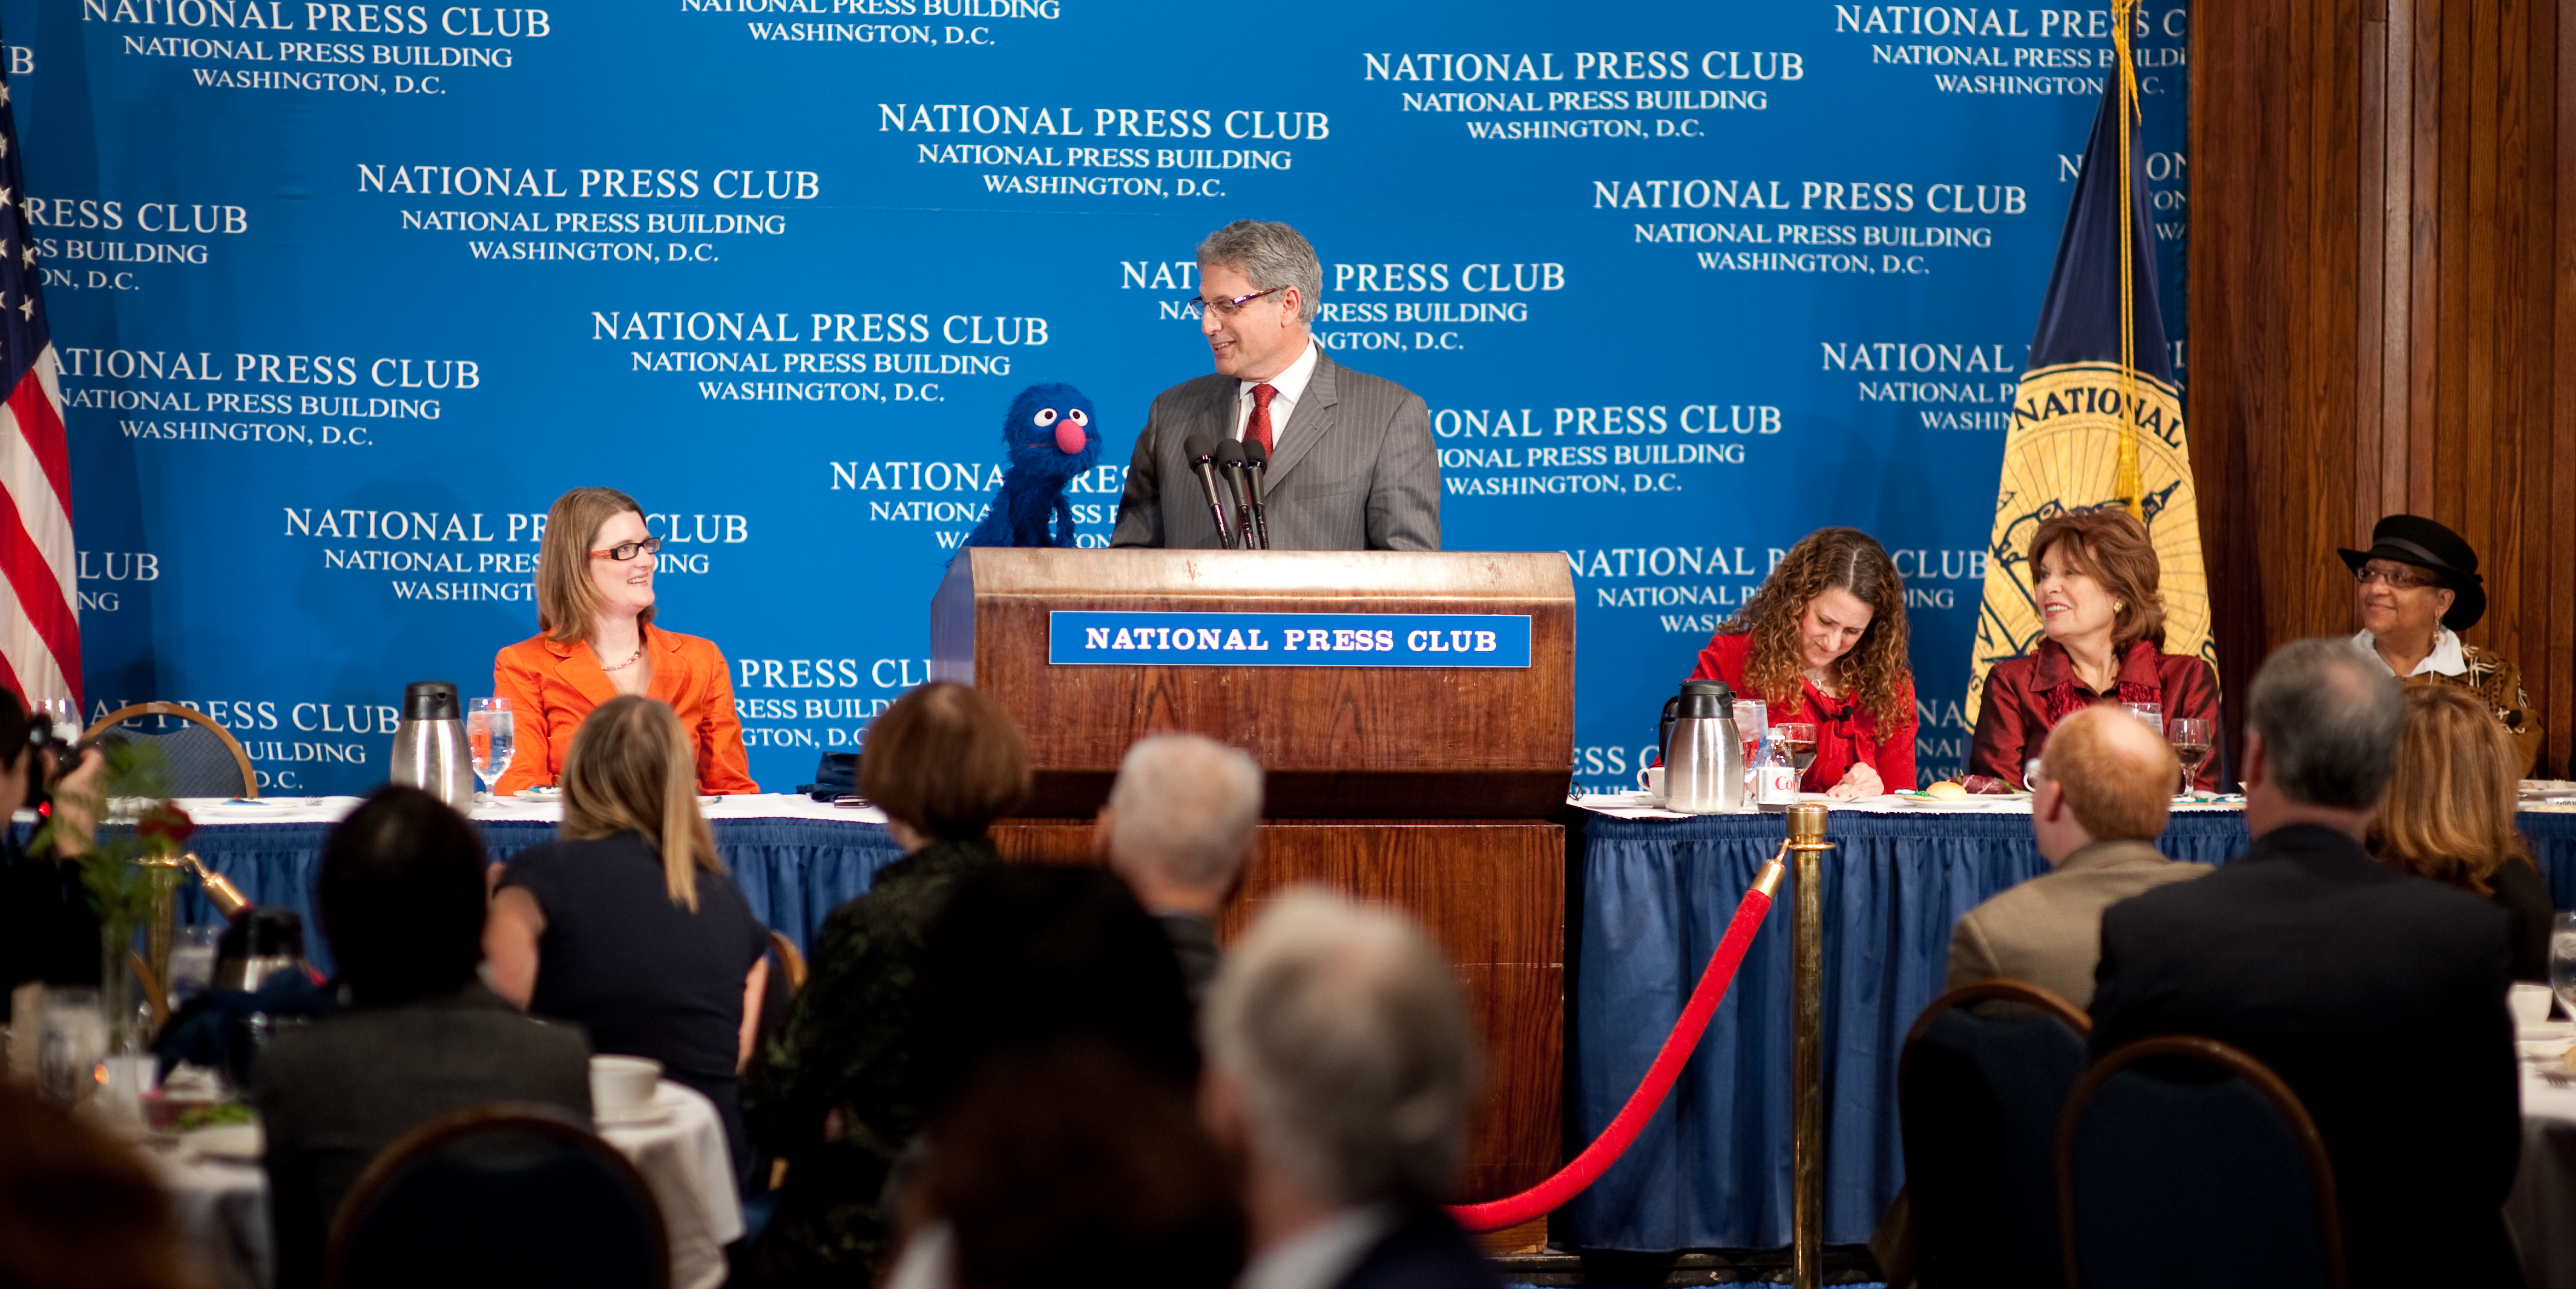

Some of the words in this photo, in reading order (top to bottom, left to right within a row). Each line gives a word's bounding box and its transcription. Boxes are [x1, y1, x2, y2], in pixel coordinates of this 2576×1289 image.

[82, 0, 294, 30] NATIONAL
[306, 3, 427, 34] PRESS
[442, 7, 550, 37] CLUB
[833, 0, 916, 15] PRESS
[924, 0, 1059, 19] BUILDING
[1835, 5, 2028, 36] NATIONAL
[2040, 8, 2150, 38] PRES
[748, 22, 938, 48] WASHINGTON,
[945, 27, 994, 45] D.C.
[123, 36, 272, 60] NATIONAL
[280, 42, 364, 63] PRESS
[373, 45, 512, 67] BUILDING
[1873, 45, 2008, 66] NATIONAL
[2015, 48, 2091, 67] PRESS
[1363, 53, 1563, 81] NATIONAL
[1576, 51, 1689, 79] PRESS
[1703, 51, 1803, 80] CLUB
[193, 69, 386, 94] WASHINGTON,
[395, 76, 445, 94] D.C.
[1402, 93, 1542, 111] NATIONAL
[1549, 91, 1629, 111] PRESS
[1636, 91, 1766, 109] BUILDING
[878, 104, 1082, 135] NATIONAL
[1095, 109, 1211, 137] PRESS
[1225, 111, 1329, 139] CLUB
[1467, 120, 1648, 139] WASHINGTON,
[1657, 119, 1704, 136] D.C.
[918, 144, 1061, 165] NATIONAL
[1068, 148, 1149, 168] PRESS
[1157, 149, 1291, 169] BUILDING
[358, 165, 567, 197] NATIONAL
[580, 169, 698, 198] PRESS
[714, 170, 818, 199] CLUB
[984, 175, 1168, 198] WASHINGTON,
[1177, 179, 1225, 197] D.C.
[1594, 180, 1789, 209] NATIONAL
[1802, 182, 1913, 211] PRESS
[1927, 184, 2026, 214] CLUB
[24, 197, 123, 230] RESS
[138, 203, 247, 233] CLUB
[401, 211, 548, 231] NATIONAL
[556, 213, 639, 232] PRESS
[648, 214, 785, 234] BUILDING
[1635, 224, 1772, 243] NATIONAL
[1778, 225, 1856, 244] PRESS
[1864, 226, 1991, 247] BUILDING
[67, 240, 207, 263] BUILDING
[469, 241, 659, 263] WASHINGTON,
[669, 243, 718, 261] D.C.
[1698, 252, 1874, 274] WASHINGTON,
[1883, 255, 1930, 274] D.C.
[88, 271, 140, 290] D.C.
[1335, 264, 1448, 291] PRESS
[1463, 263, 1564, 292] CLUB
[1395, 303, 1526, 321] BUILDING
[592, 312, 798, 341] NATIONAL
[811, 313, 928, 342] PRESS
[944, 315, 1048, 345] CLUB
[1311, 332, 1408, 352] NGTON,
[1416, 332, 1463, 349] D.C.
[631, 352, 777, 372] NATIONAL
[784, 353, 866, 372] PRESS
[875, 354, 1010, 375] BUILDING
[1822, 343, 2014, 373] NATIONAL
[235, 354, 356, 385] PRESS
[372, 358, 479, 388] CLUB
[698, 382, 886, 402] WASHINGTON,
[895, 384, 944, 401] D.C.
[1860, 382, 1993, 402] NATIONAL
[208, 393, 292, 413] PRESS
[301, 396, 440, 419] BUILDING
[1554, 406, 1667, 435] PRESS
[1681, 405, 1781, 433] CLUB
[119, 421, 314, 447] WASHINGTON,
[323, 427, 372, 445] D.C.
[1438, 448, 1522, 468] IONAL
[1528, 447, 1606, 467] PRESS
[1615, 444, 1744, 464] BUILDING
[829, 462, 1004, 491] NATIONA
[1446, 475, 1626, 494] WASHINGTON,
[1635, 474, 1681, 491] D.C.
[869, 501, 991, 522] NATIONA
[284, 508, 493, 541] NATIONAL
[646, 513, 749, 544] CLUB
[77, 551, 160, 581] LUB
[324, 549, 472, 572] NATIONAL
[1892, 548, 1988, 580] CLUB
[1597, 585, 1735, 607] NATIONAL
[1085, 628, 1269, 650] NATIONAL
[1284, 630, 1393, 651] PRESS
[1407, 630, 1496, 652] CLUB
[739, 659, 858, 687] PRESS
[292, 703, 402, 733] CLUB
[733, 698, 798, 720] RESS
[238, 741, 366, 764] UILDING
